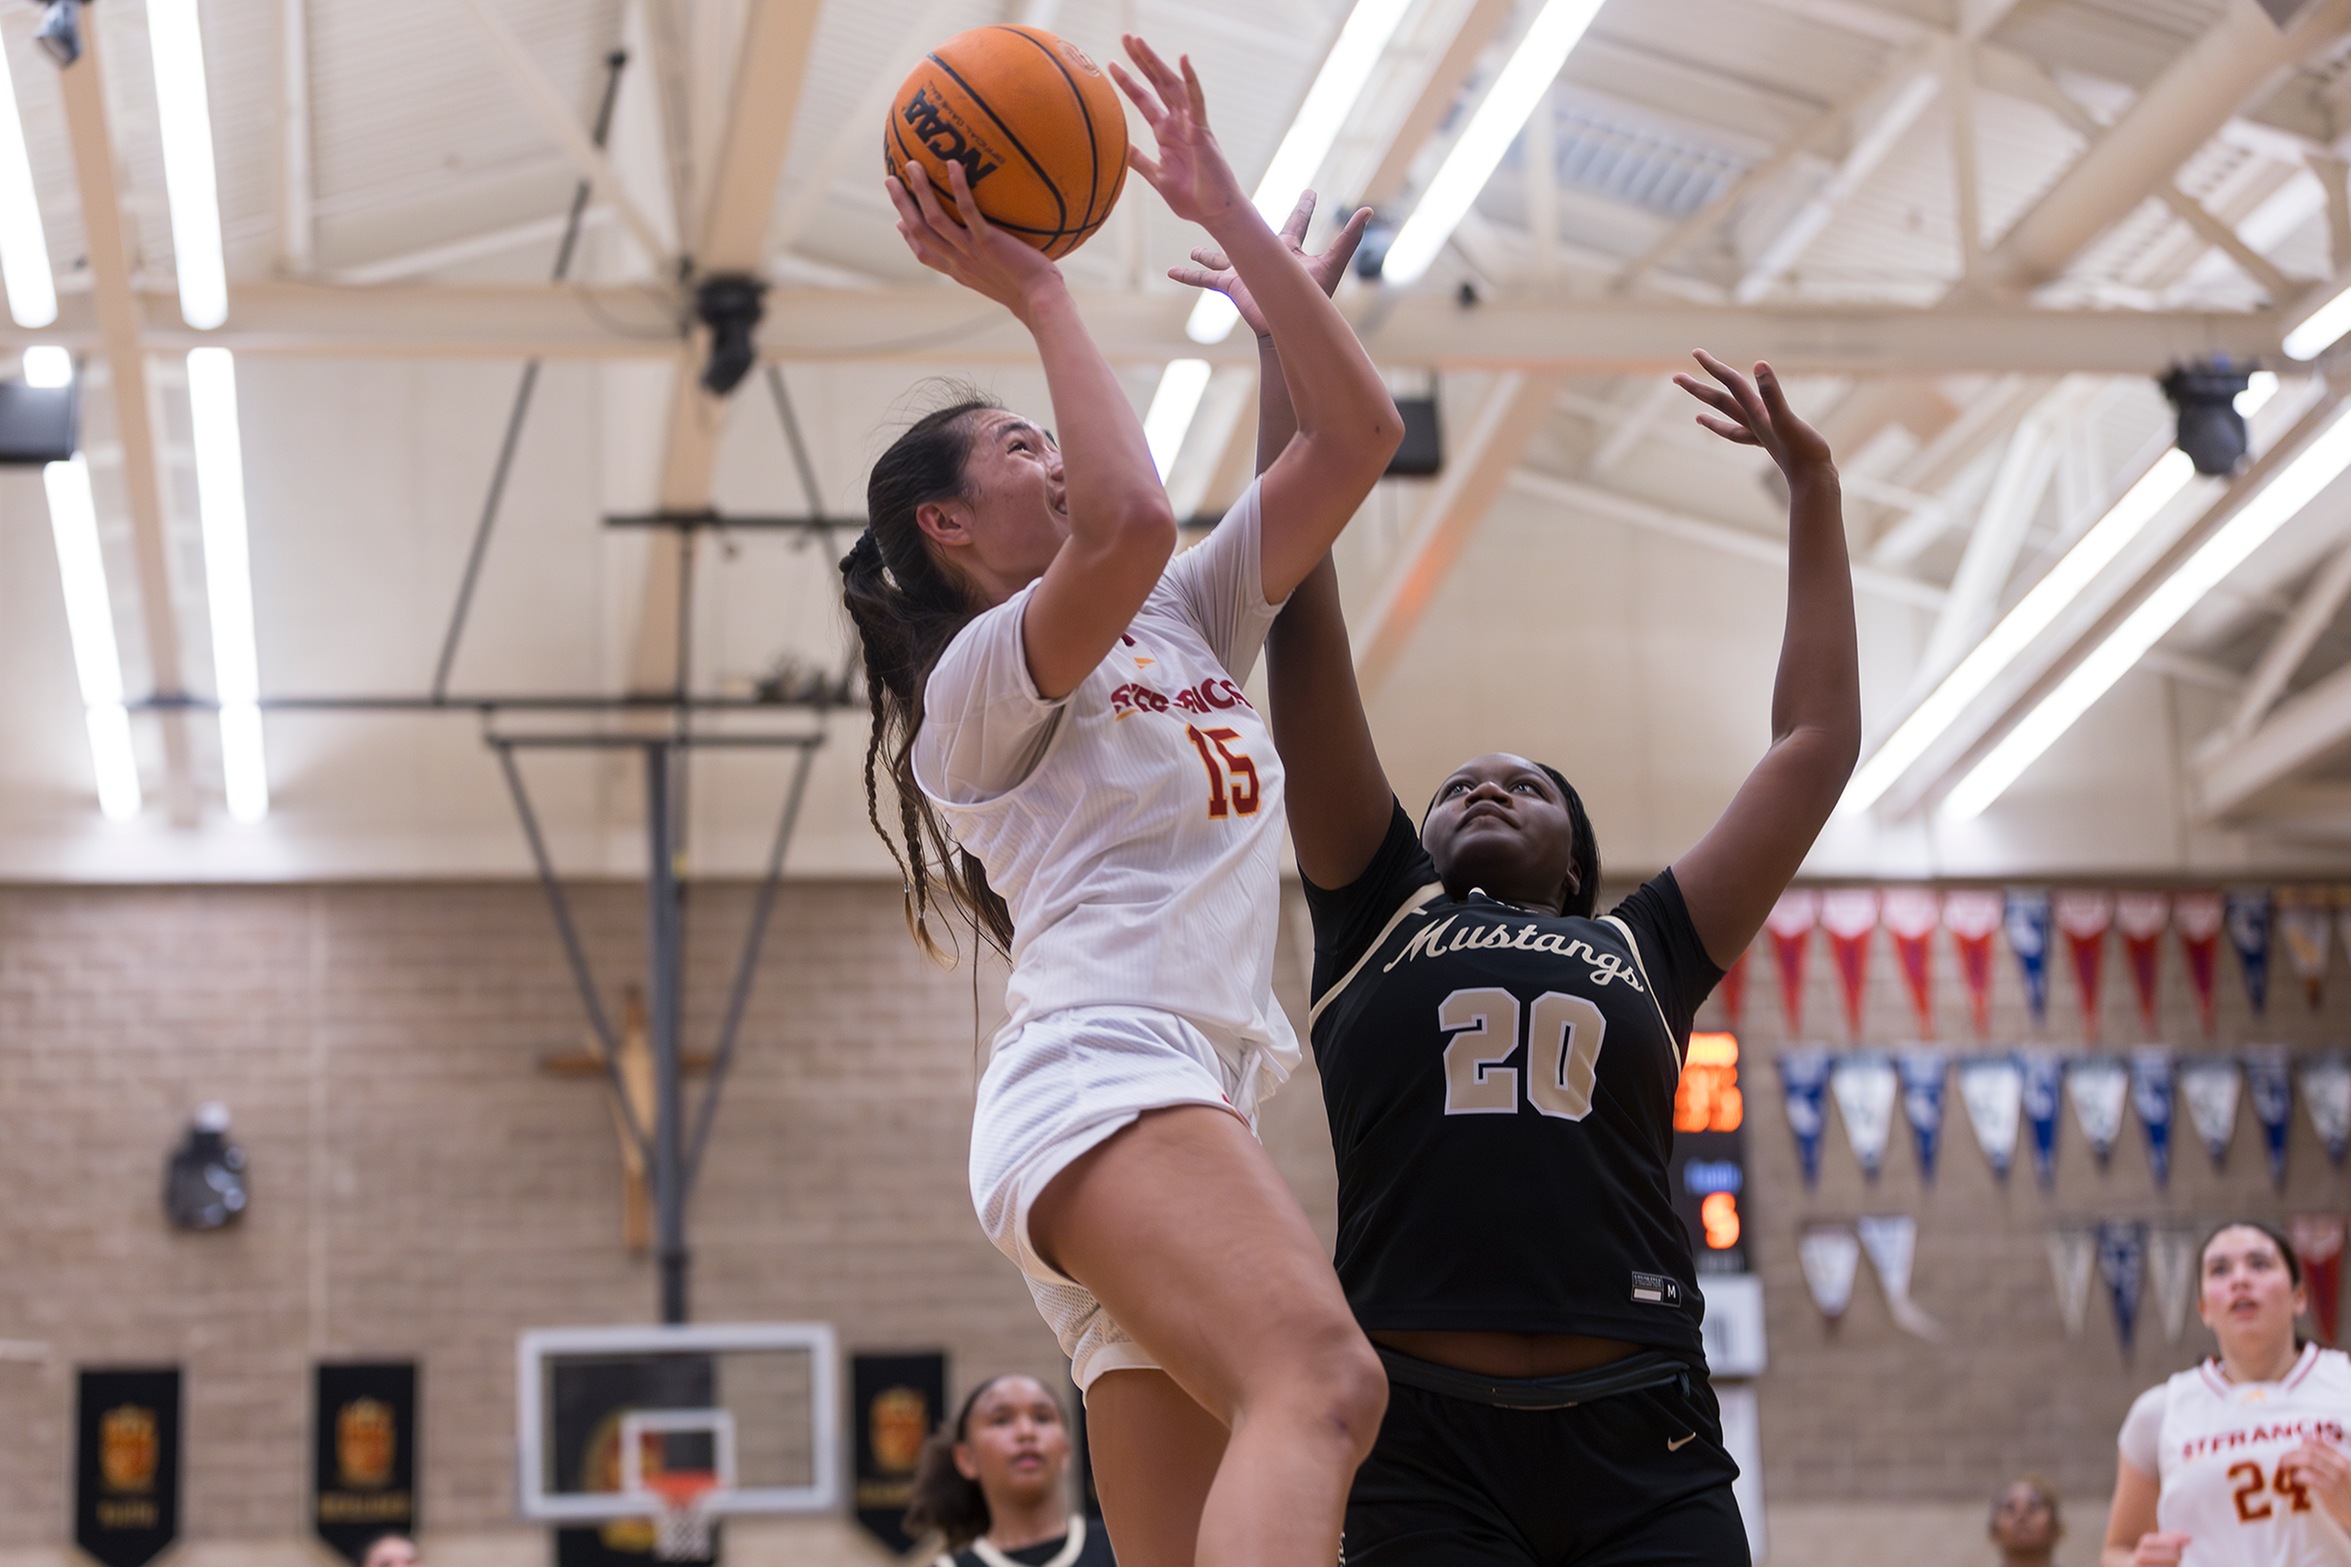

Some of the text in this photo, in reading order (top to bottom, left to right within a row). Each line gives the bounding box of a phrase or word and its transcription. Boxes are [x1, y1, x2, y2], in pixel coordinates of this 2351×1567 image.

[903, 87, 998, 189] NCAA
[1185, 722, 1262, 820] 15
[1383, 914, 1645, 993] Mustangs
[1437, 986, 1607, 1123] 20
[2226, 1459, 2312, 1525] 24
